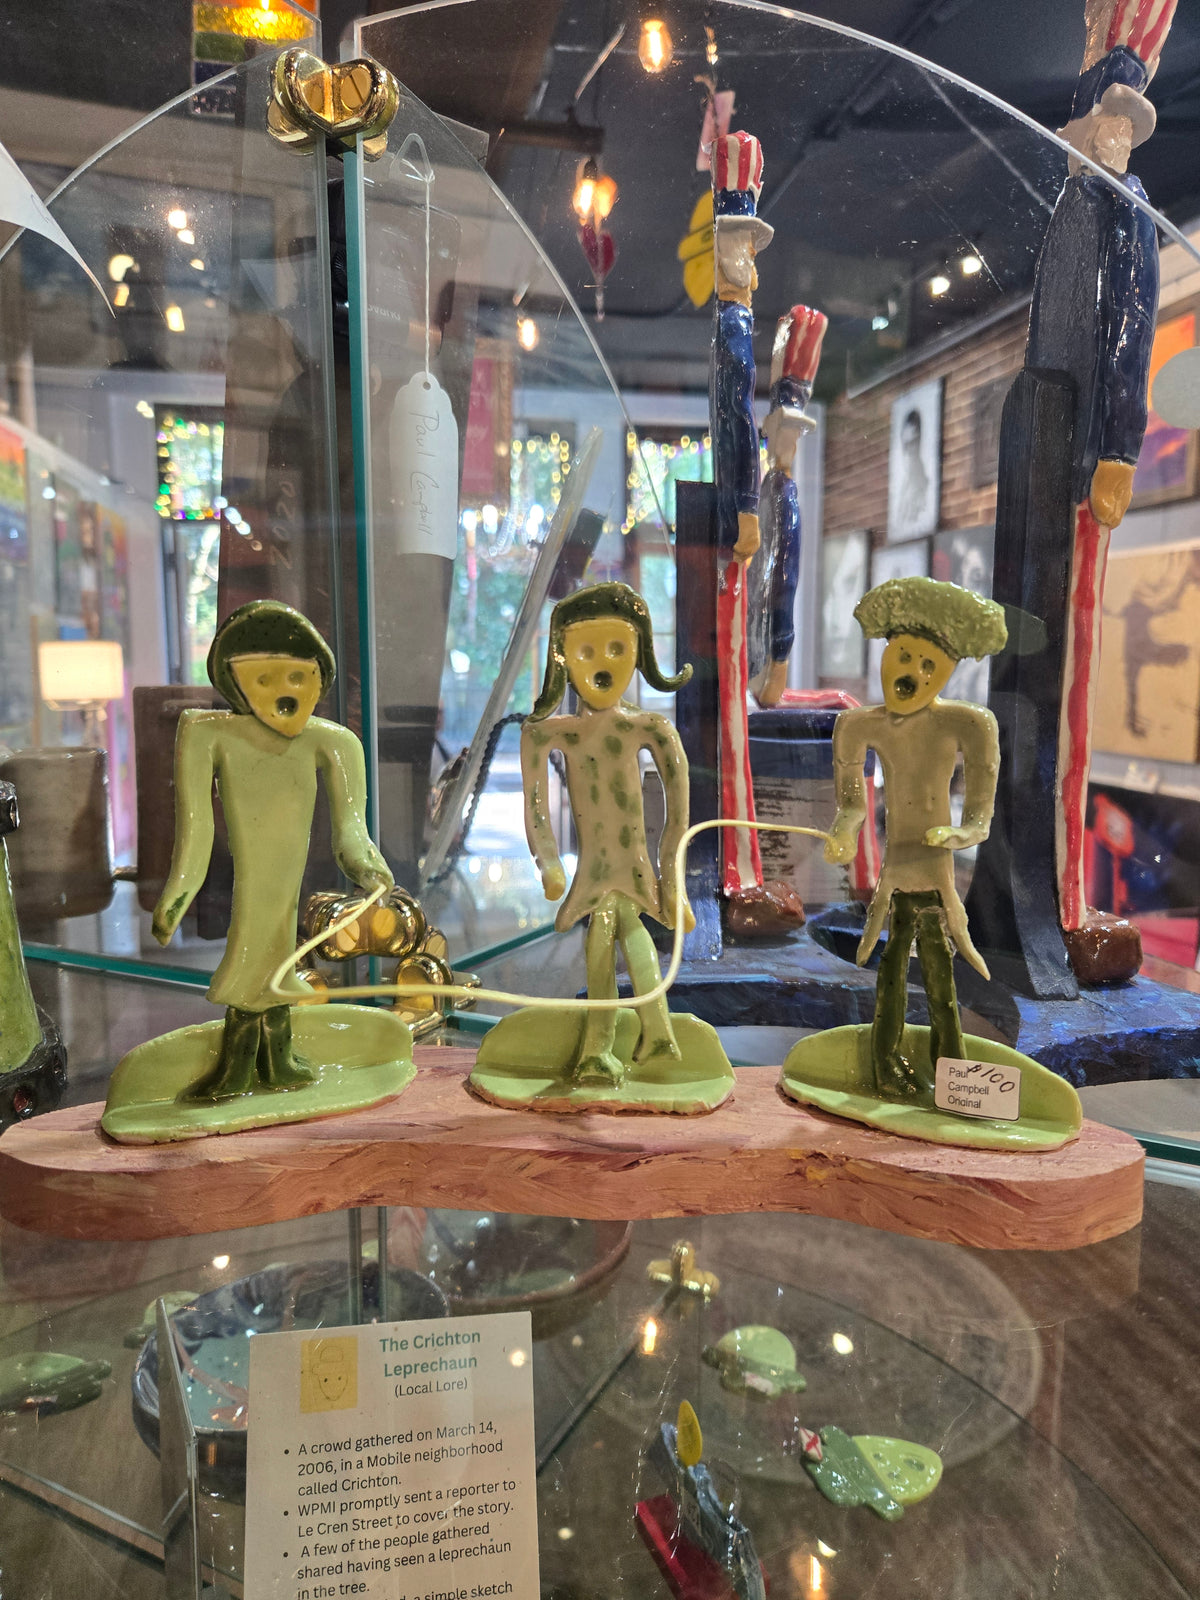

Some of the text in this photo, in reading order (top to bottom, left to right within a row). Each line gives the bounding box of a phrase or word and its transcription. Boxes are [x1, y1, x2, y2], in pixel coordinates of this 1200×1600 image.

[408, 410, 439, 457] Paul
[949, 1066, 968, 1079] Paul
[967, 1063, 1015, 1093] $100
[947, 1081, 990, 1095] Campbell
[947, 1094, 982, 1109] Original
[379, 1331, 481, 1352] The Crichton
[384, 1356, 478, 1379] Leprechaun
[394, 1377, 468, 1398] (Local Lore)
[298, 1421, 497, 1456] A crowd gathered on March 14,
[298, 1439, 503, 1476] 2006, in a Mobile neighborhood
[298, 1475, 402, 1496] called Crichton.
[298, 1480, 516, 1517] WPMI promptly sent a reporter to
[298, 1502, 514, 1538] Le Cren Street to cover the story.
[301, 1522, 490, 1558] A few of the people gathered
[297, 1542, 511, 1580] shared having seen a leprechaun
[297, 1582, 370, 1600] in the tree.
[424, 1580, 513, 1600] simple sketch
